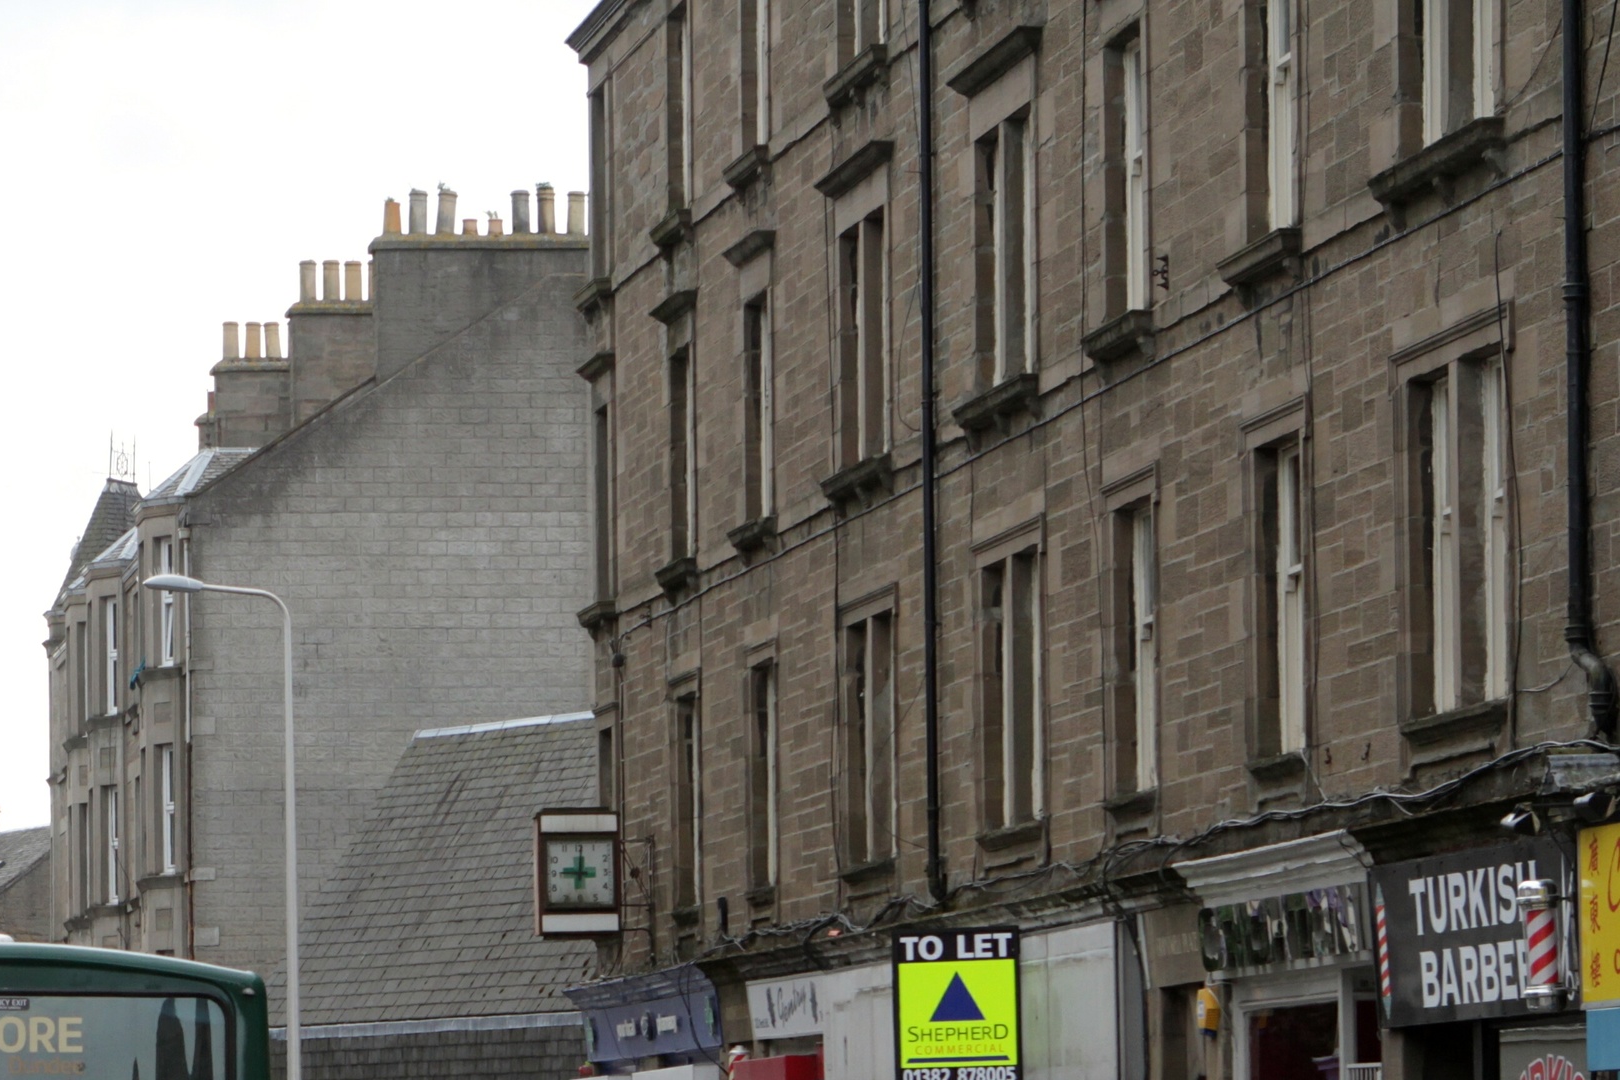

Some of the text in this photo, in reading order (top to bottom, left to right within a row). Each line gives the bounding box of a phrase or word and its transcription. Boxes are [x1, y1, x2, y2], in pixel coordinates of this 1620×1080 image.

[899, 932, 1012, 961] TO LET
[12, 998, 28, 1006] EXIT
[908, 1023, 1009, 1043] SHEPHERD
[914, 1043, 1005, 1056] COMMERCIAL
[8, 1056, 85, 1075] Dundee
